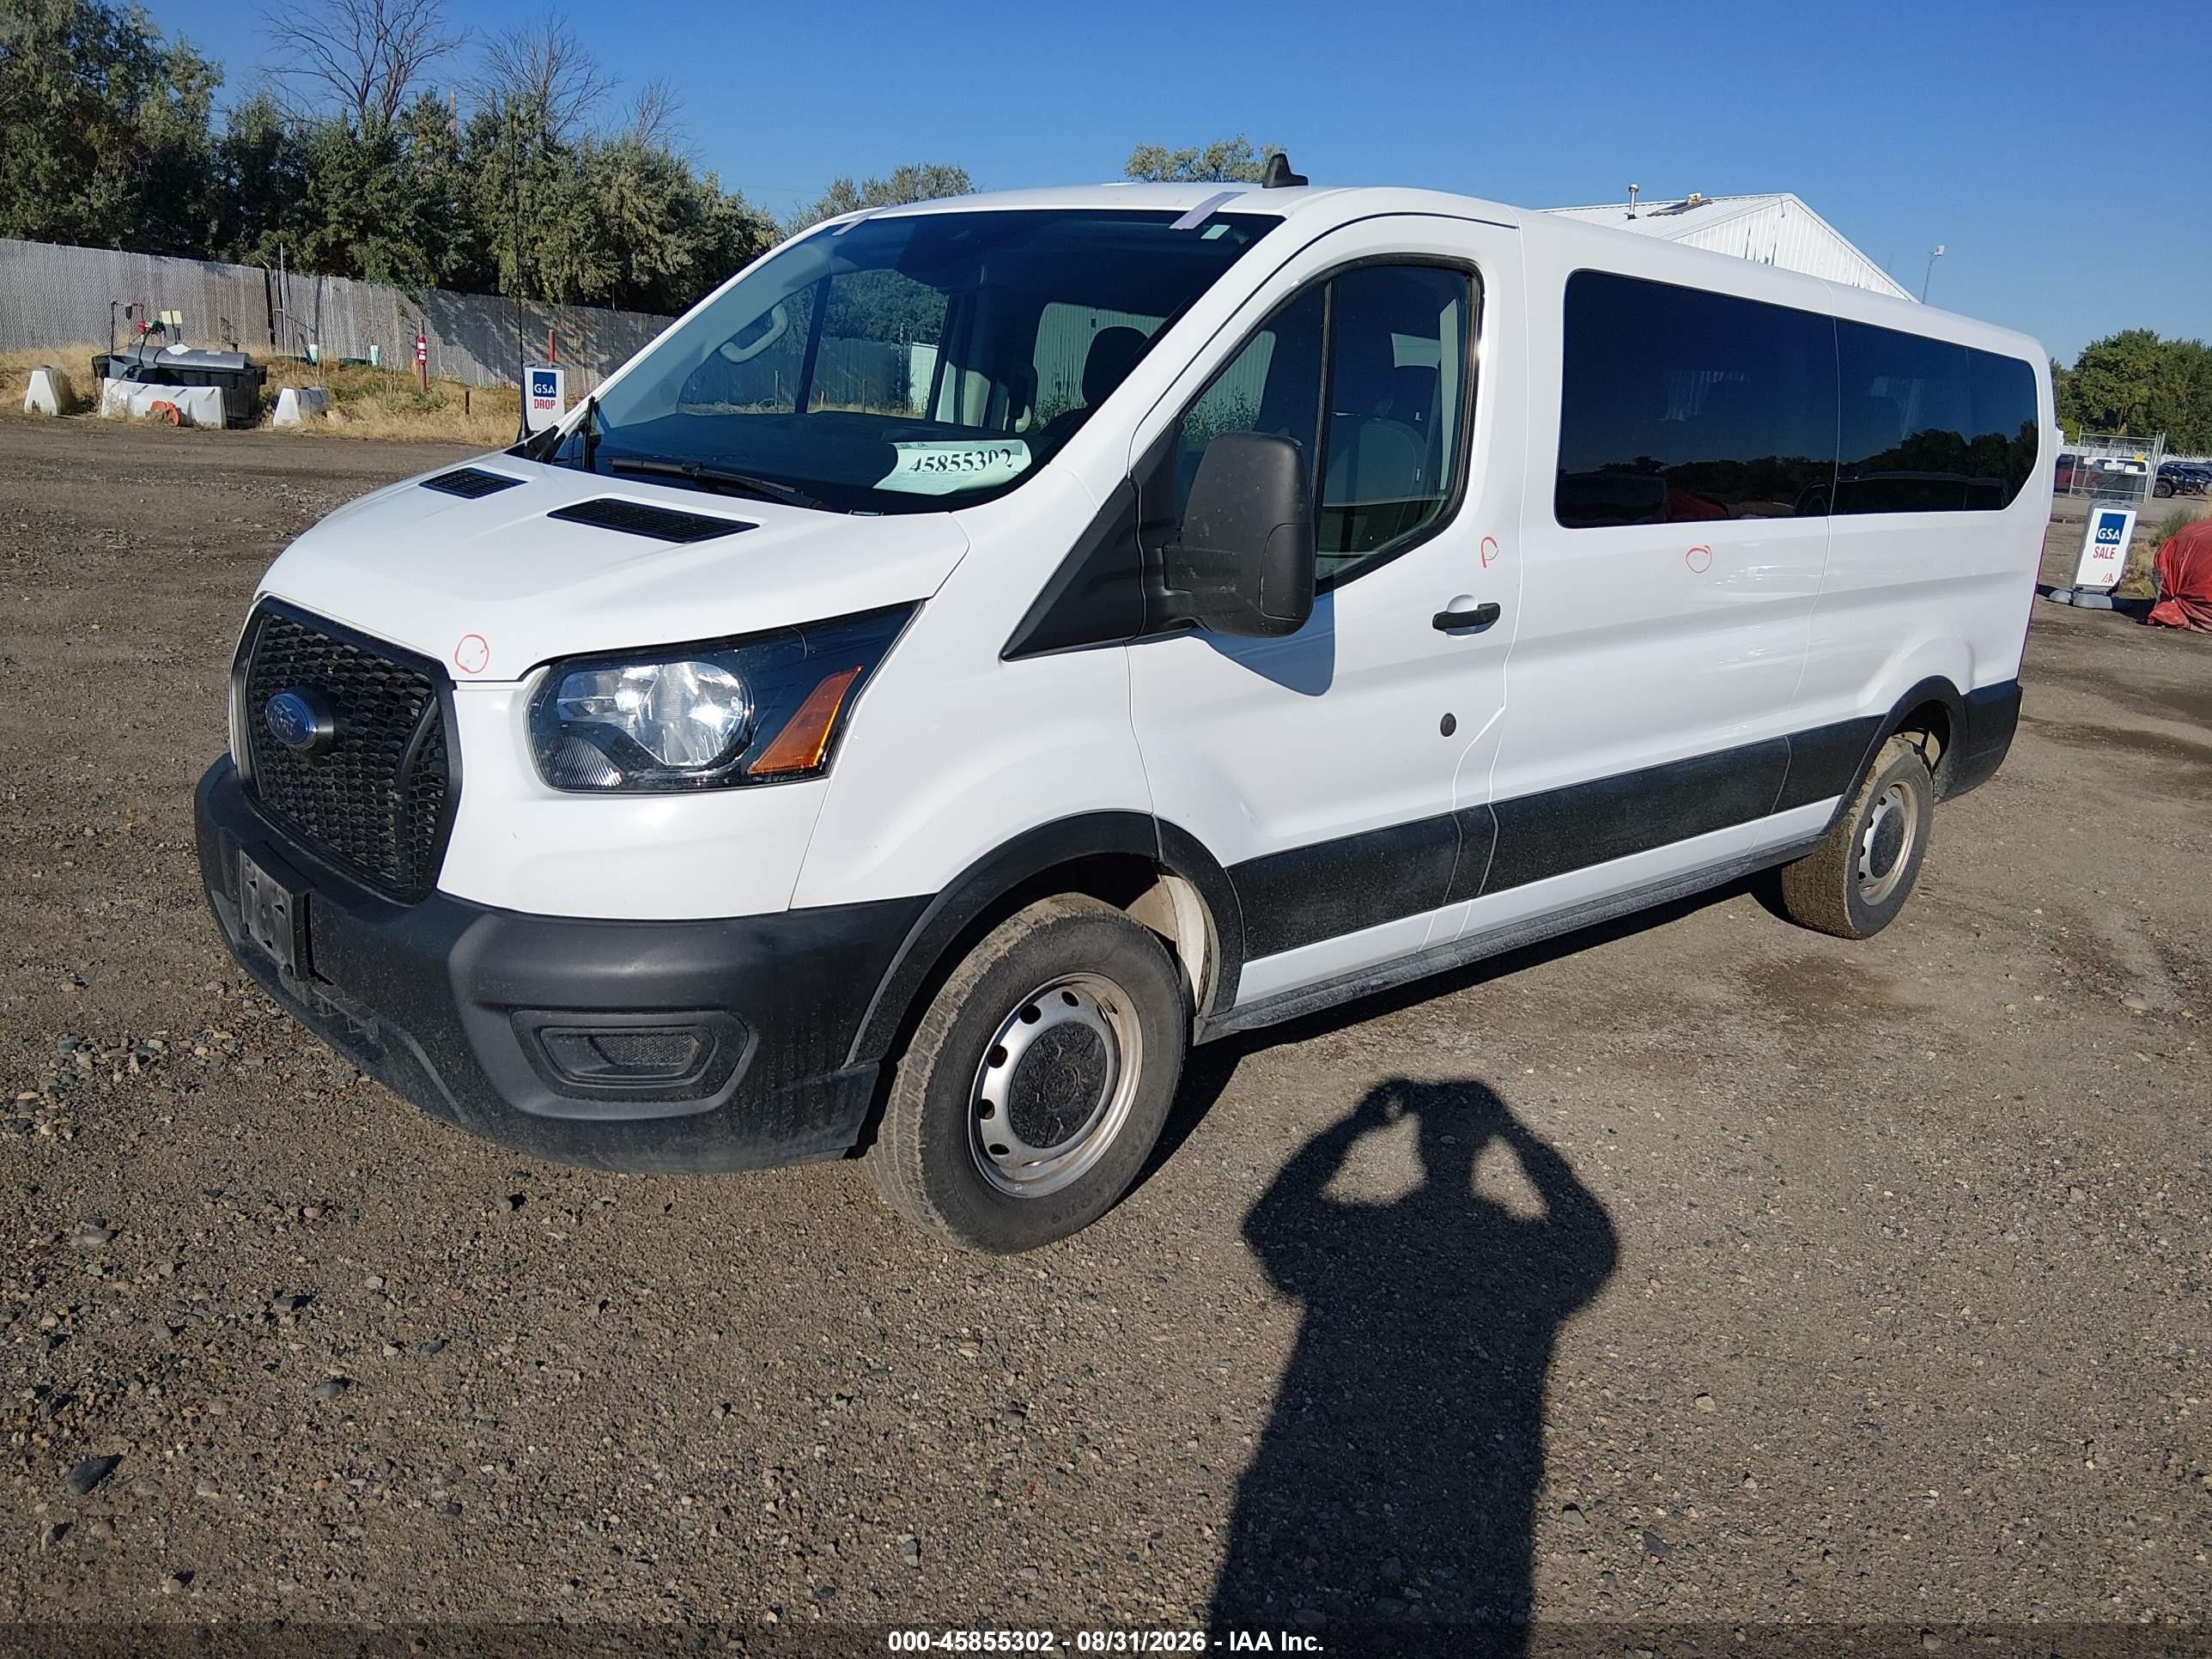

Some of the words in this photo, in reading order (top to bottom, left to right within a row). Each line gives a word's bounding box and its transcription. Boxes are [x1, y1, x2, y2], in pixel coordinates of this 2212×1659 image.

[534, 384, 556, 394] GSA
[534, 399, 556, 410] DROP
[908, 448, 1013, 472] 45855302
[2098, 528, 2120, 540] GSA
[2093, 545, 2117, 559] SALE
